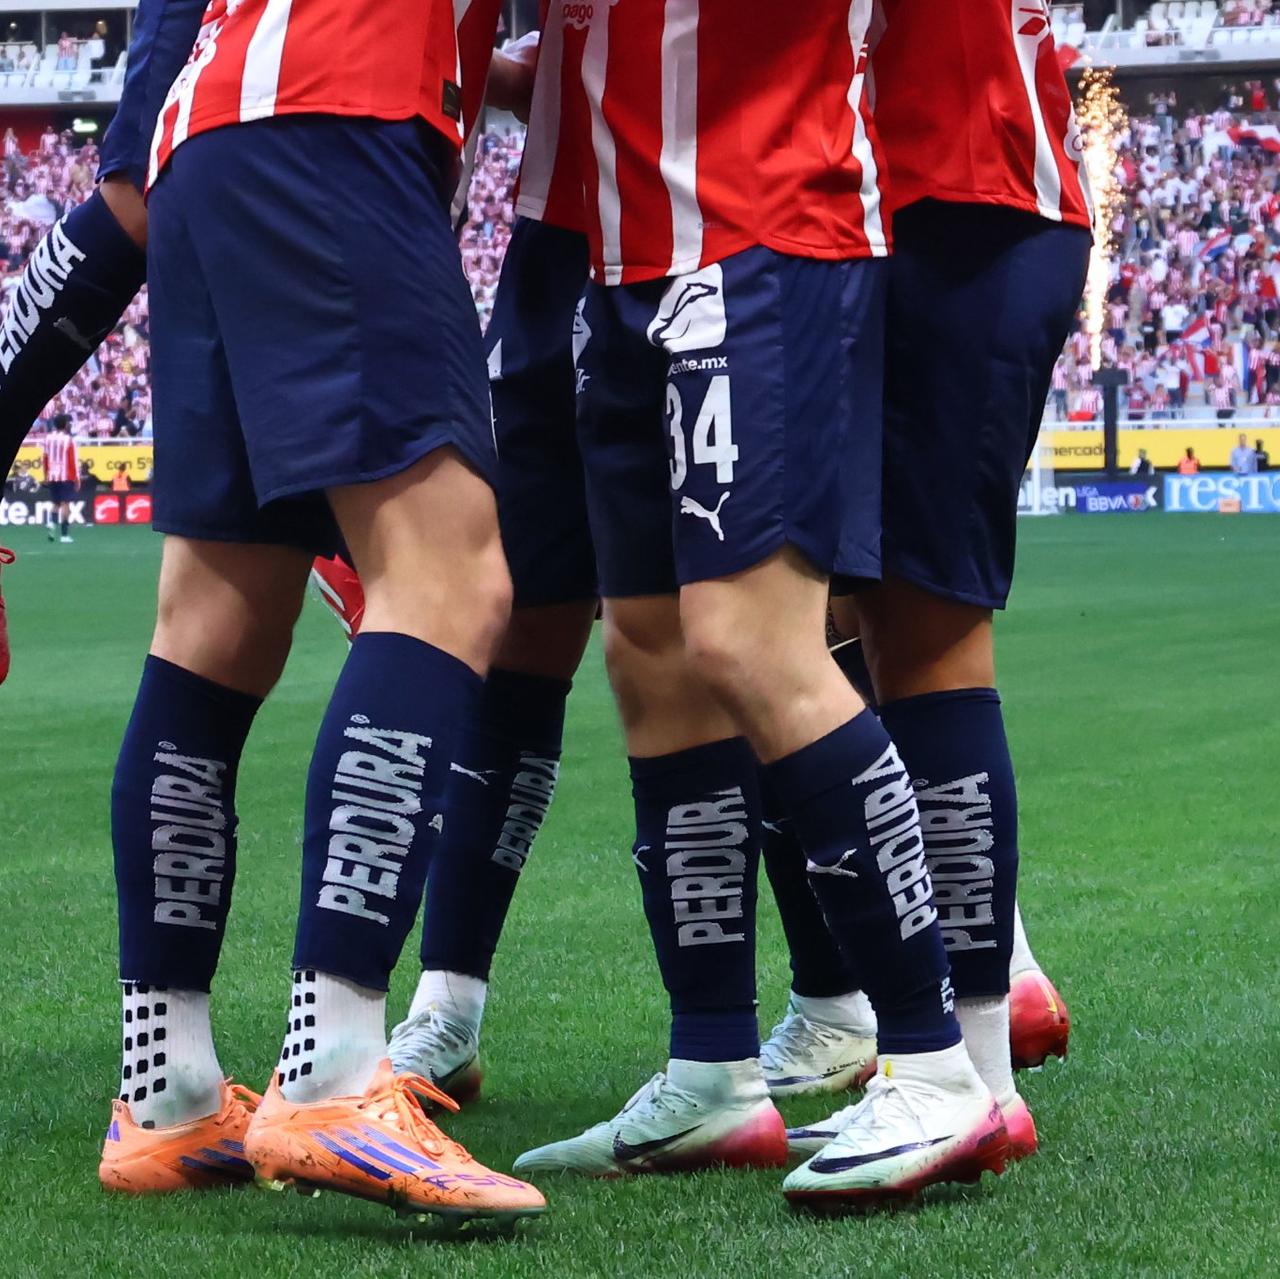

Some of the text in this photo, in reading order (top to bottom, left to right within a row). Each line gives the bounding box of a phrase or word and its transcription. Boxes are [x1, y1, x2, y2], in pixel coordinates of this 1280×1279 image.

[666, 374, 739, 490] 34
[1088, 496, 1128, 512] BBVA
[154, 751, 227, 930] PERDURA
[316, 725, 433, 926] PERDURA
[491, 755, 561, 872] PERDURA
[852, 740, 938, 942] PERDURA
